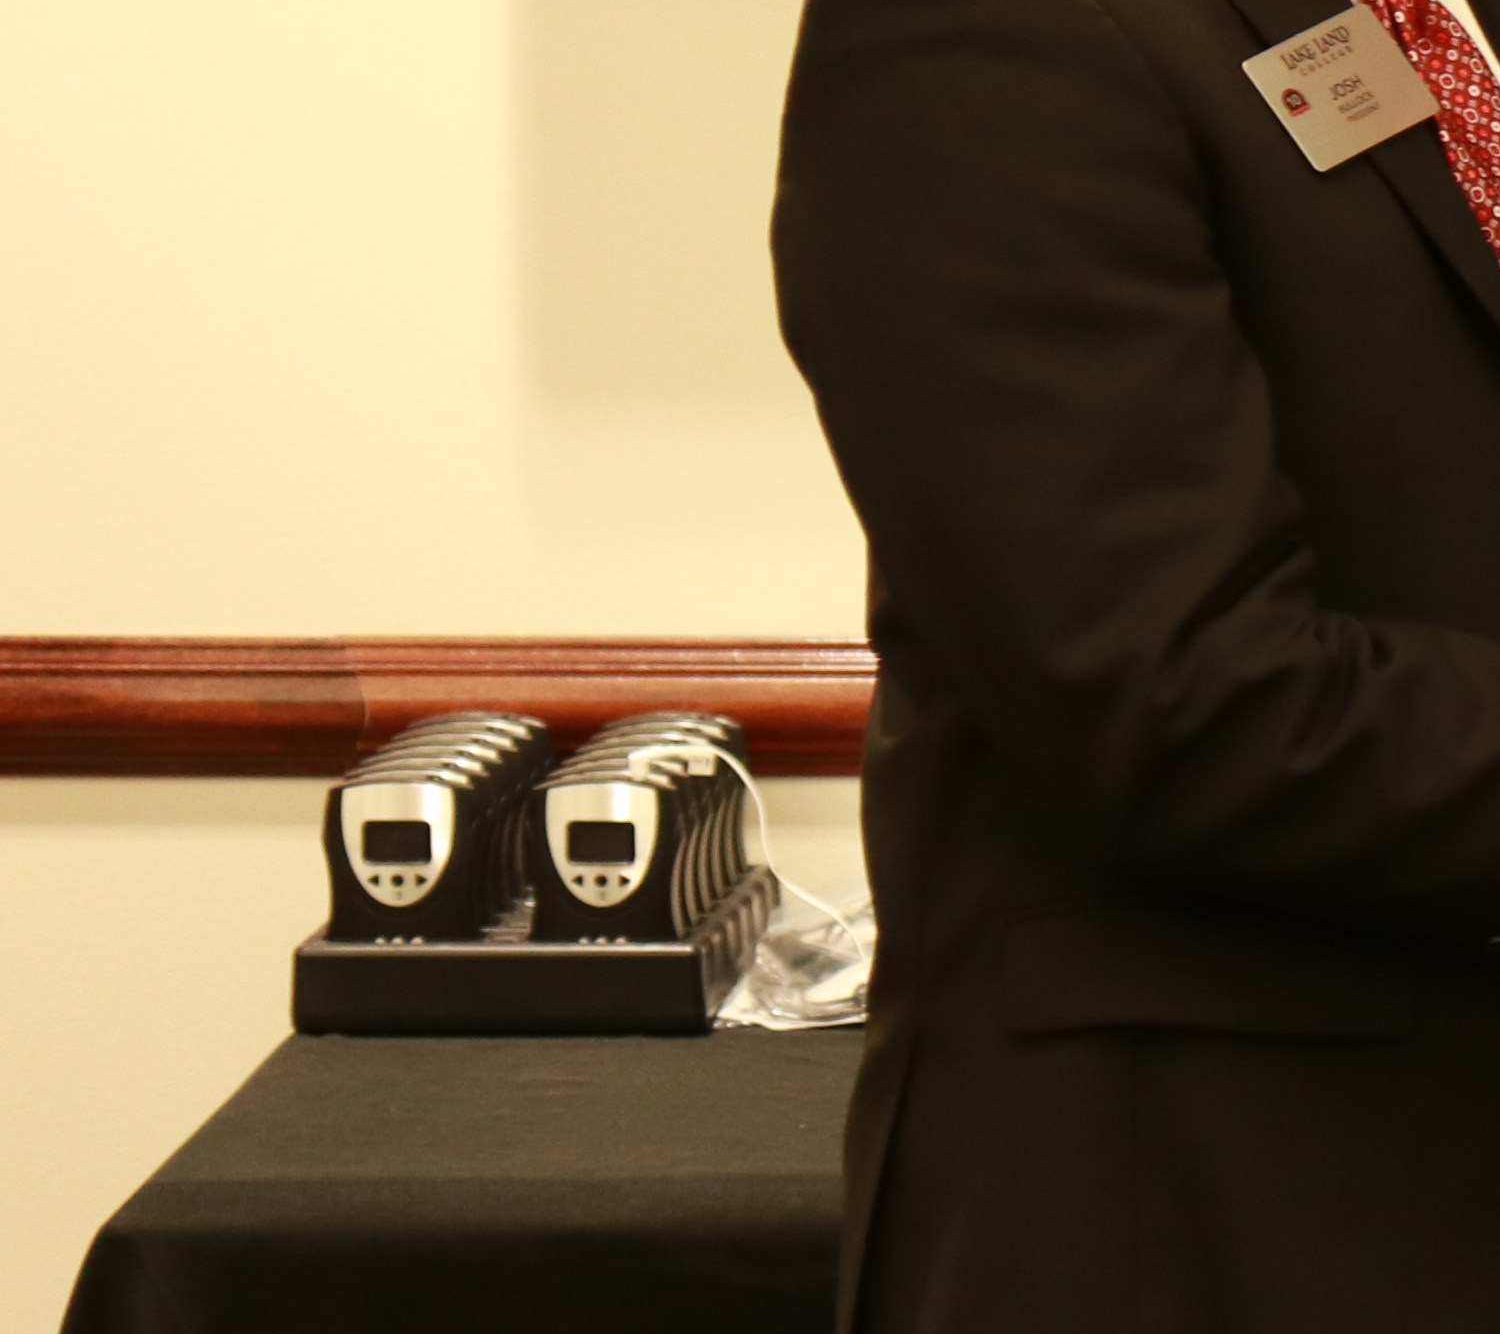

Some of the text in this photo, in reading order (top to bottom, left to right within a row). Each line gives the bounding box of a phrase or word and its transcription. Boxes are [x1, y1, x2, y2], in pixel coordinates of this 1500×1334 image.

[1280, 27, 1349, 70] LAKE LAND
[1300, 45, 1354, 76] COLLEGE
[1330, 74, 1364, 101] JOSH
